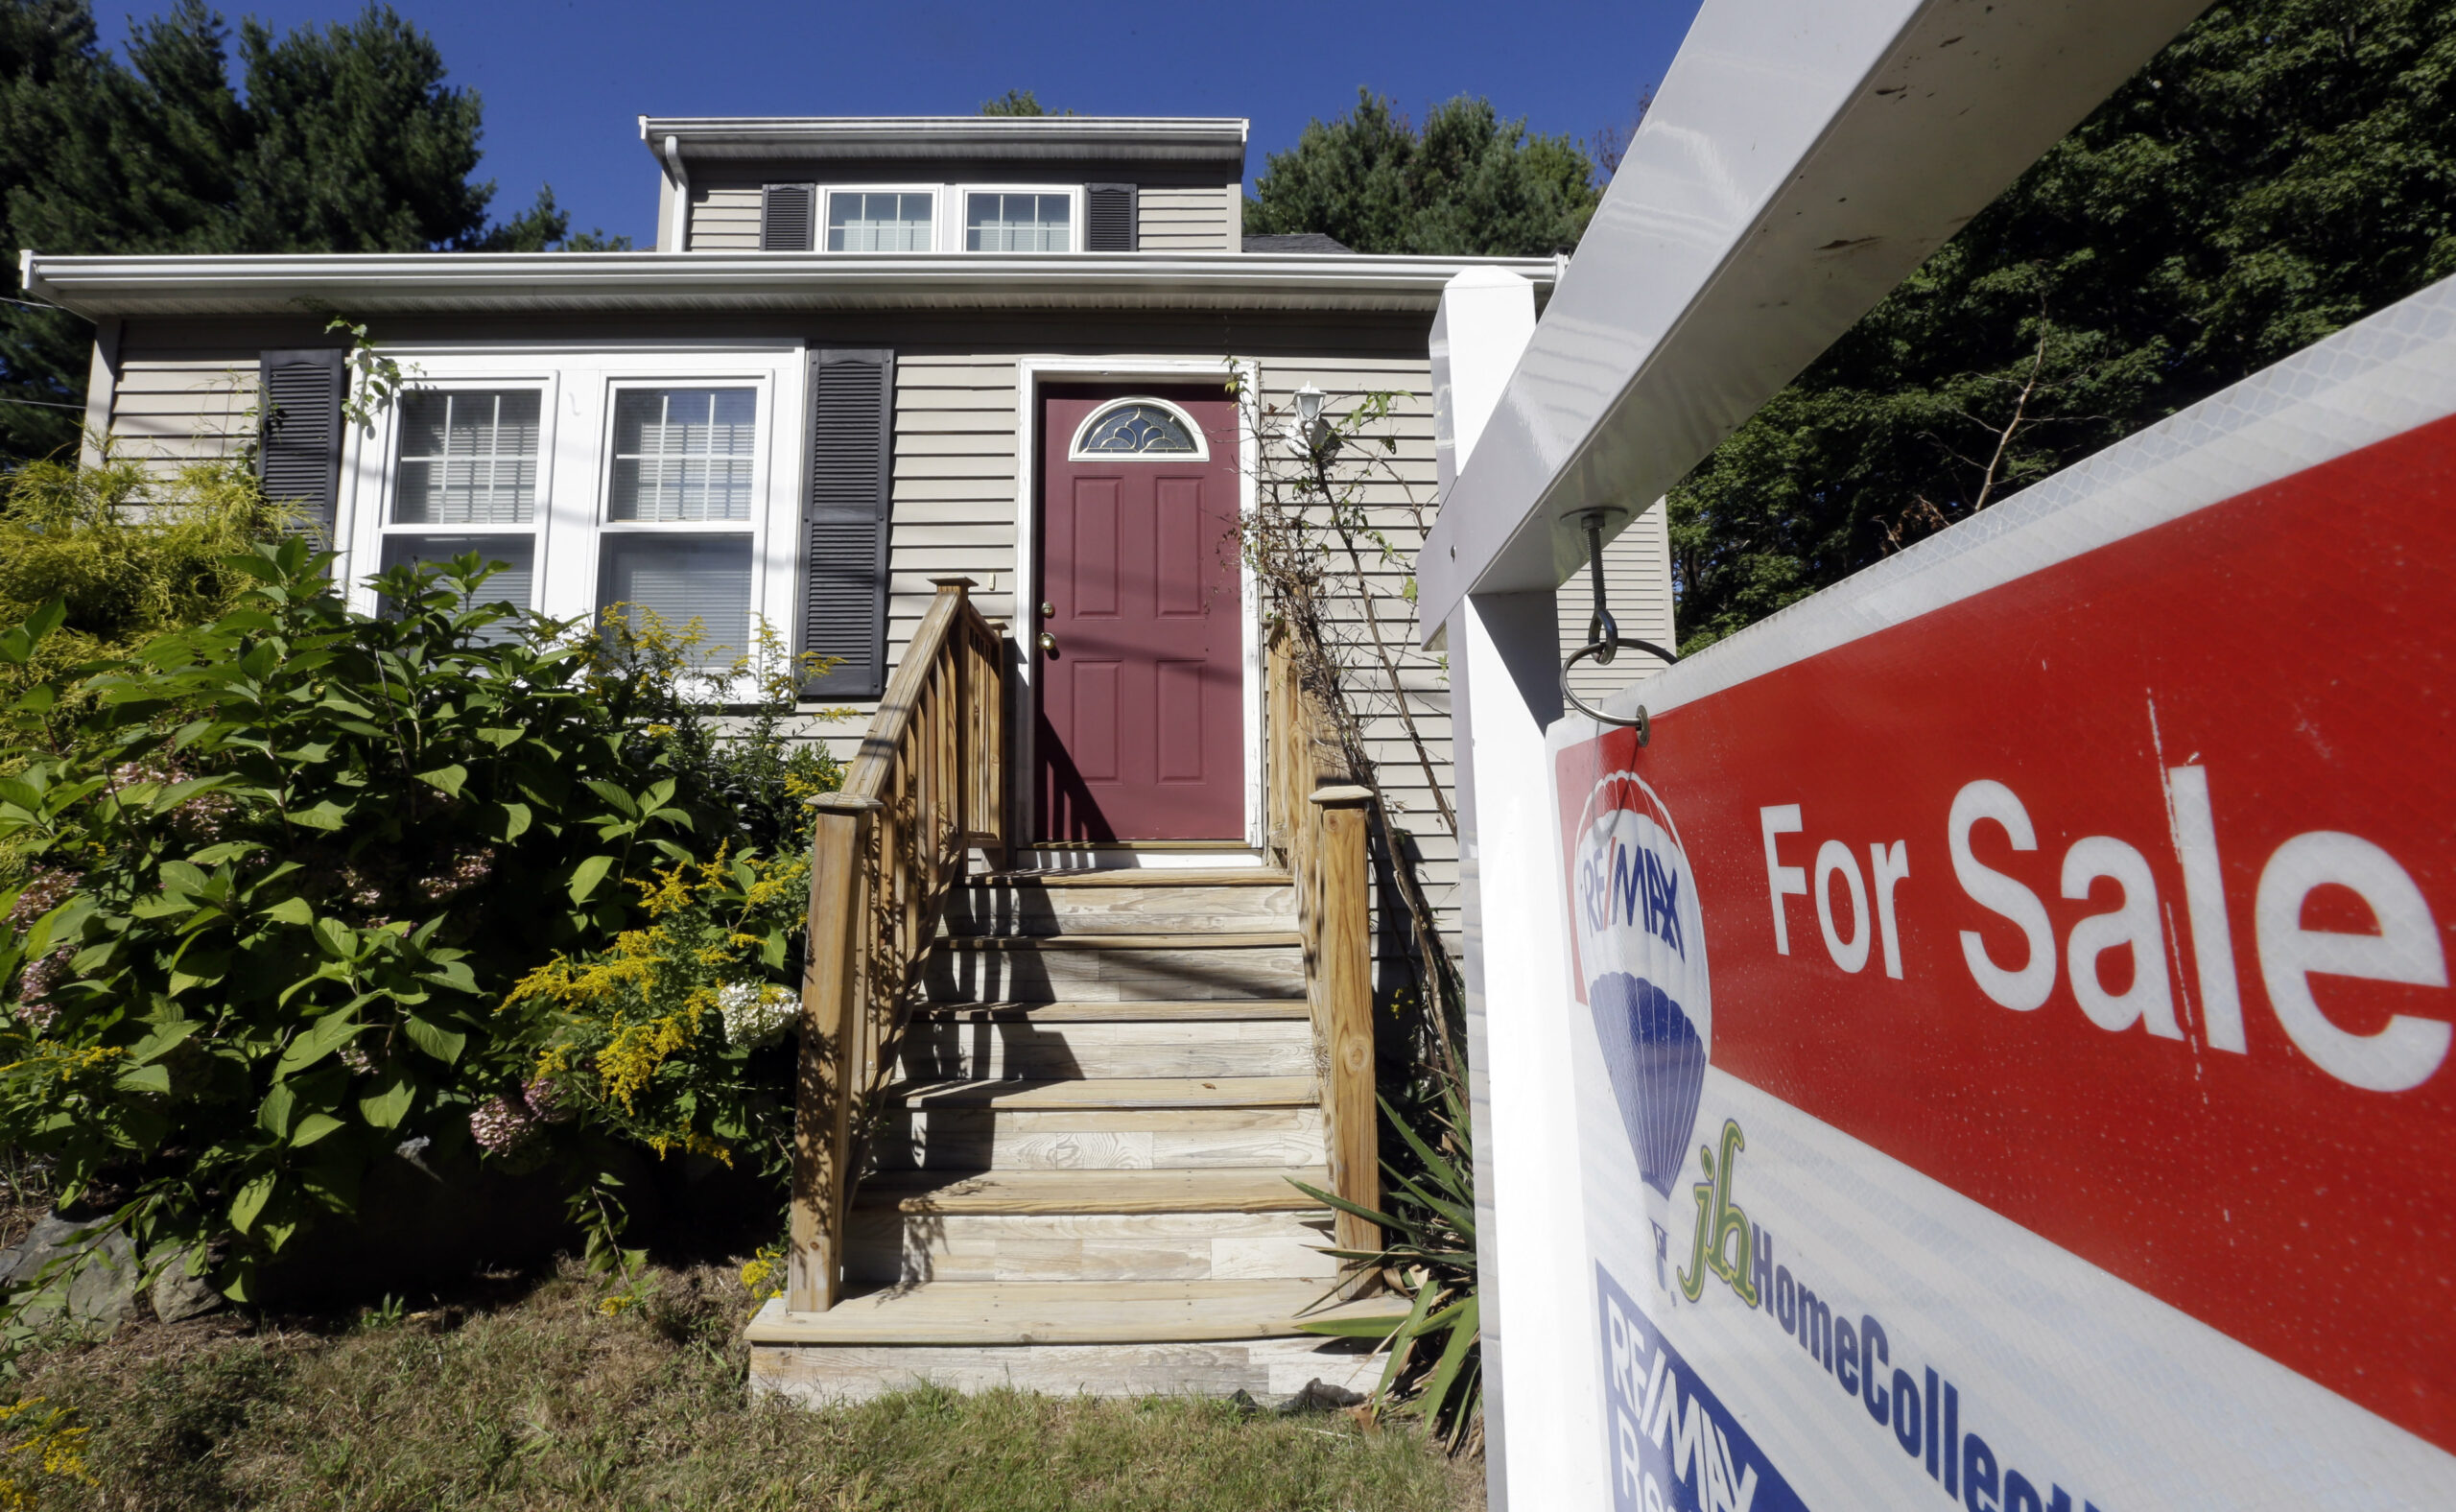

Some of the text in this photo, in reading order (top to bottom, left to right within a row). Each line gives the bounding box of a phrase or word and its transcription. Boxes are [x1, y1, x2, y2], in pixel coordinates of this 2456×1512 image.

[1583, 836, 1686, 964] RE/MAX
[1759, 764, 2452, 1093] For Sale
[1752, 1221, 2101, 1512] HomeColle
